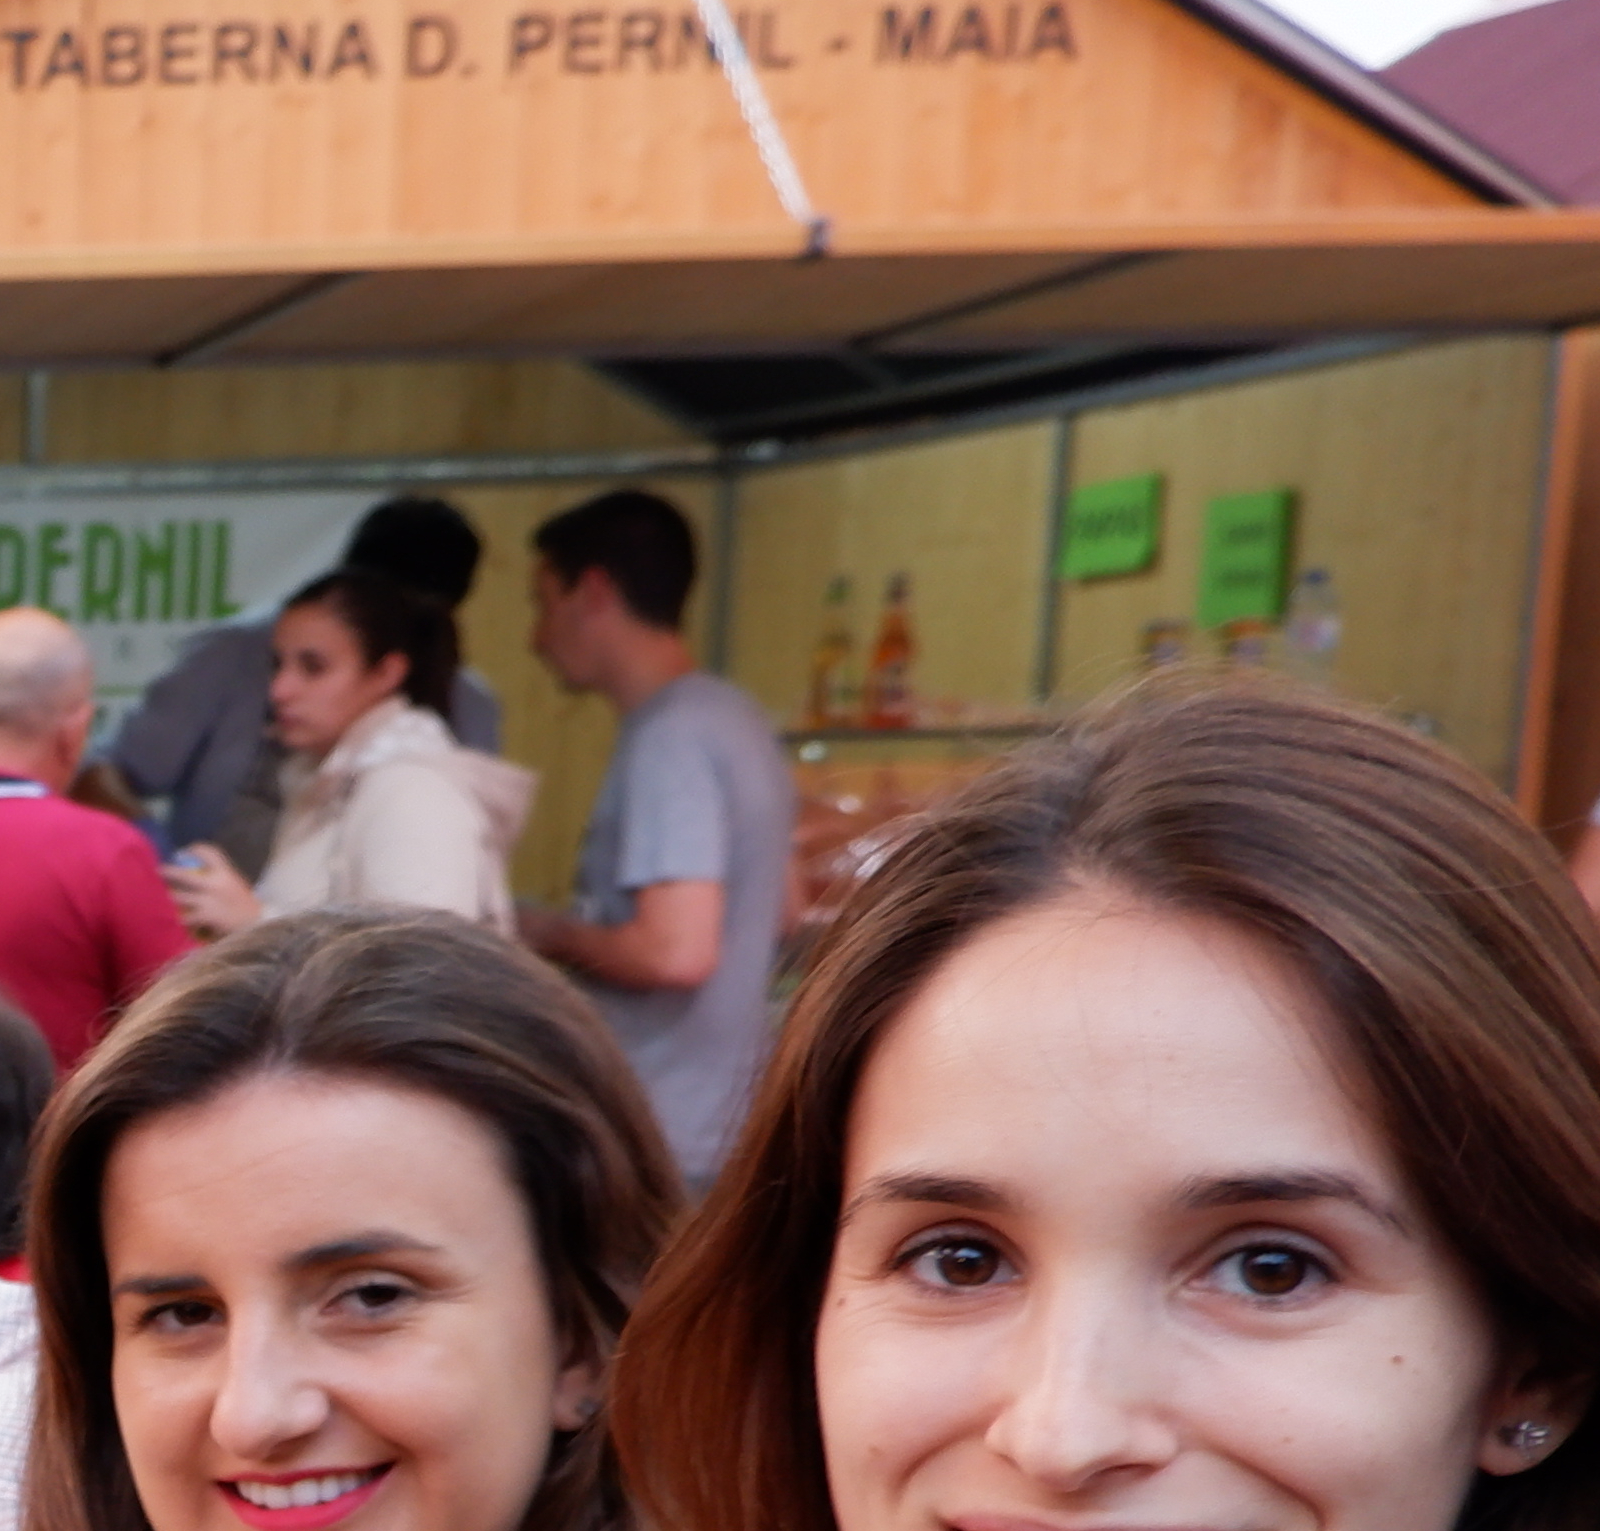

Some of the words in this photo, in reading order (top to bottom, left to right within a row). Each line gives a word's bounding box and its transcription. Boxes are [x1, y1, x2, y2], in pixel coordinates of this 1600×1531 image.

[404, 16, 478, 79] D.
[508, 9, 794, 75] PERNIL
[876, 3, 1079, 63] MAIA
